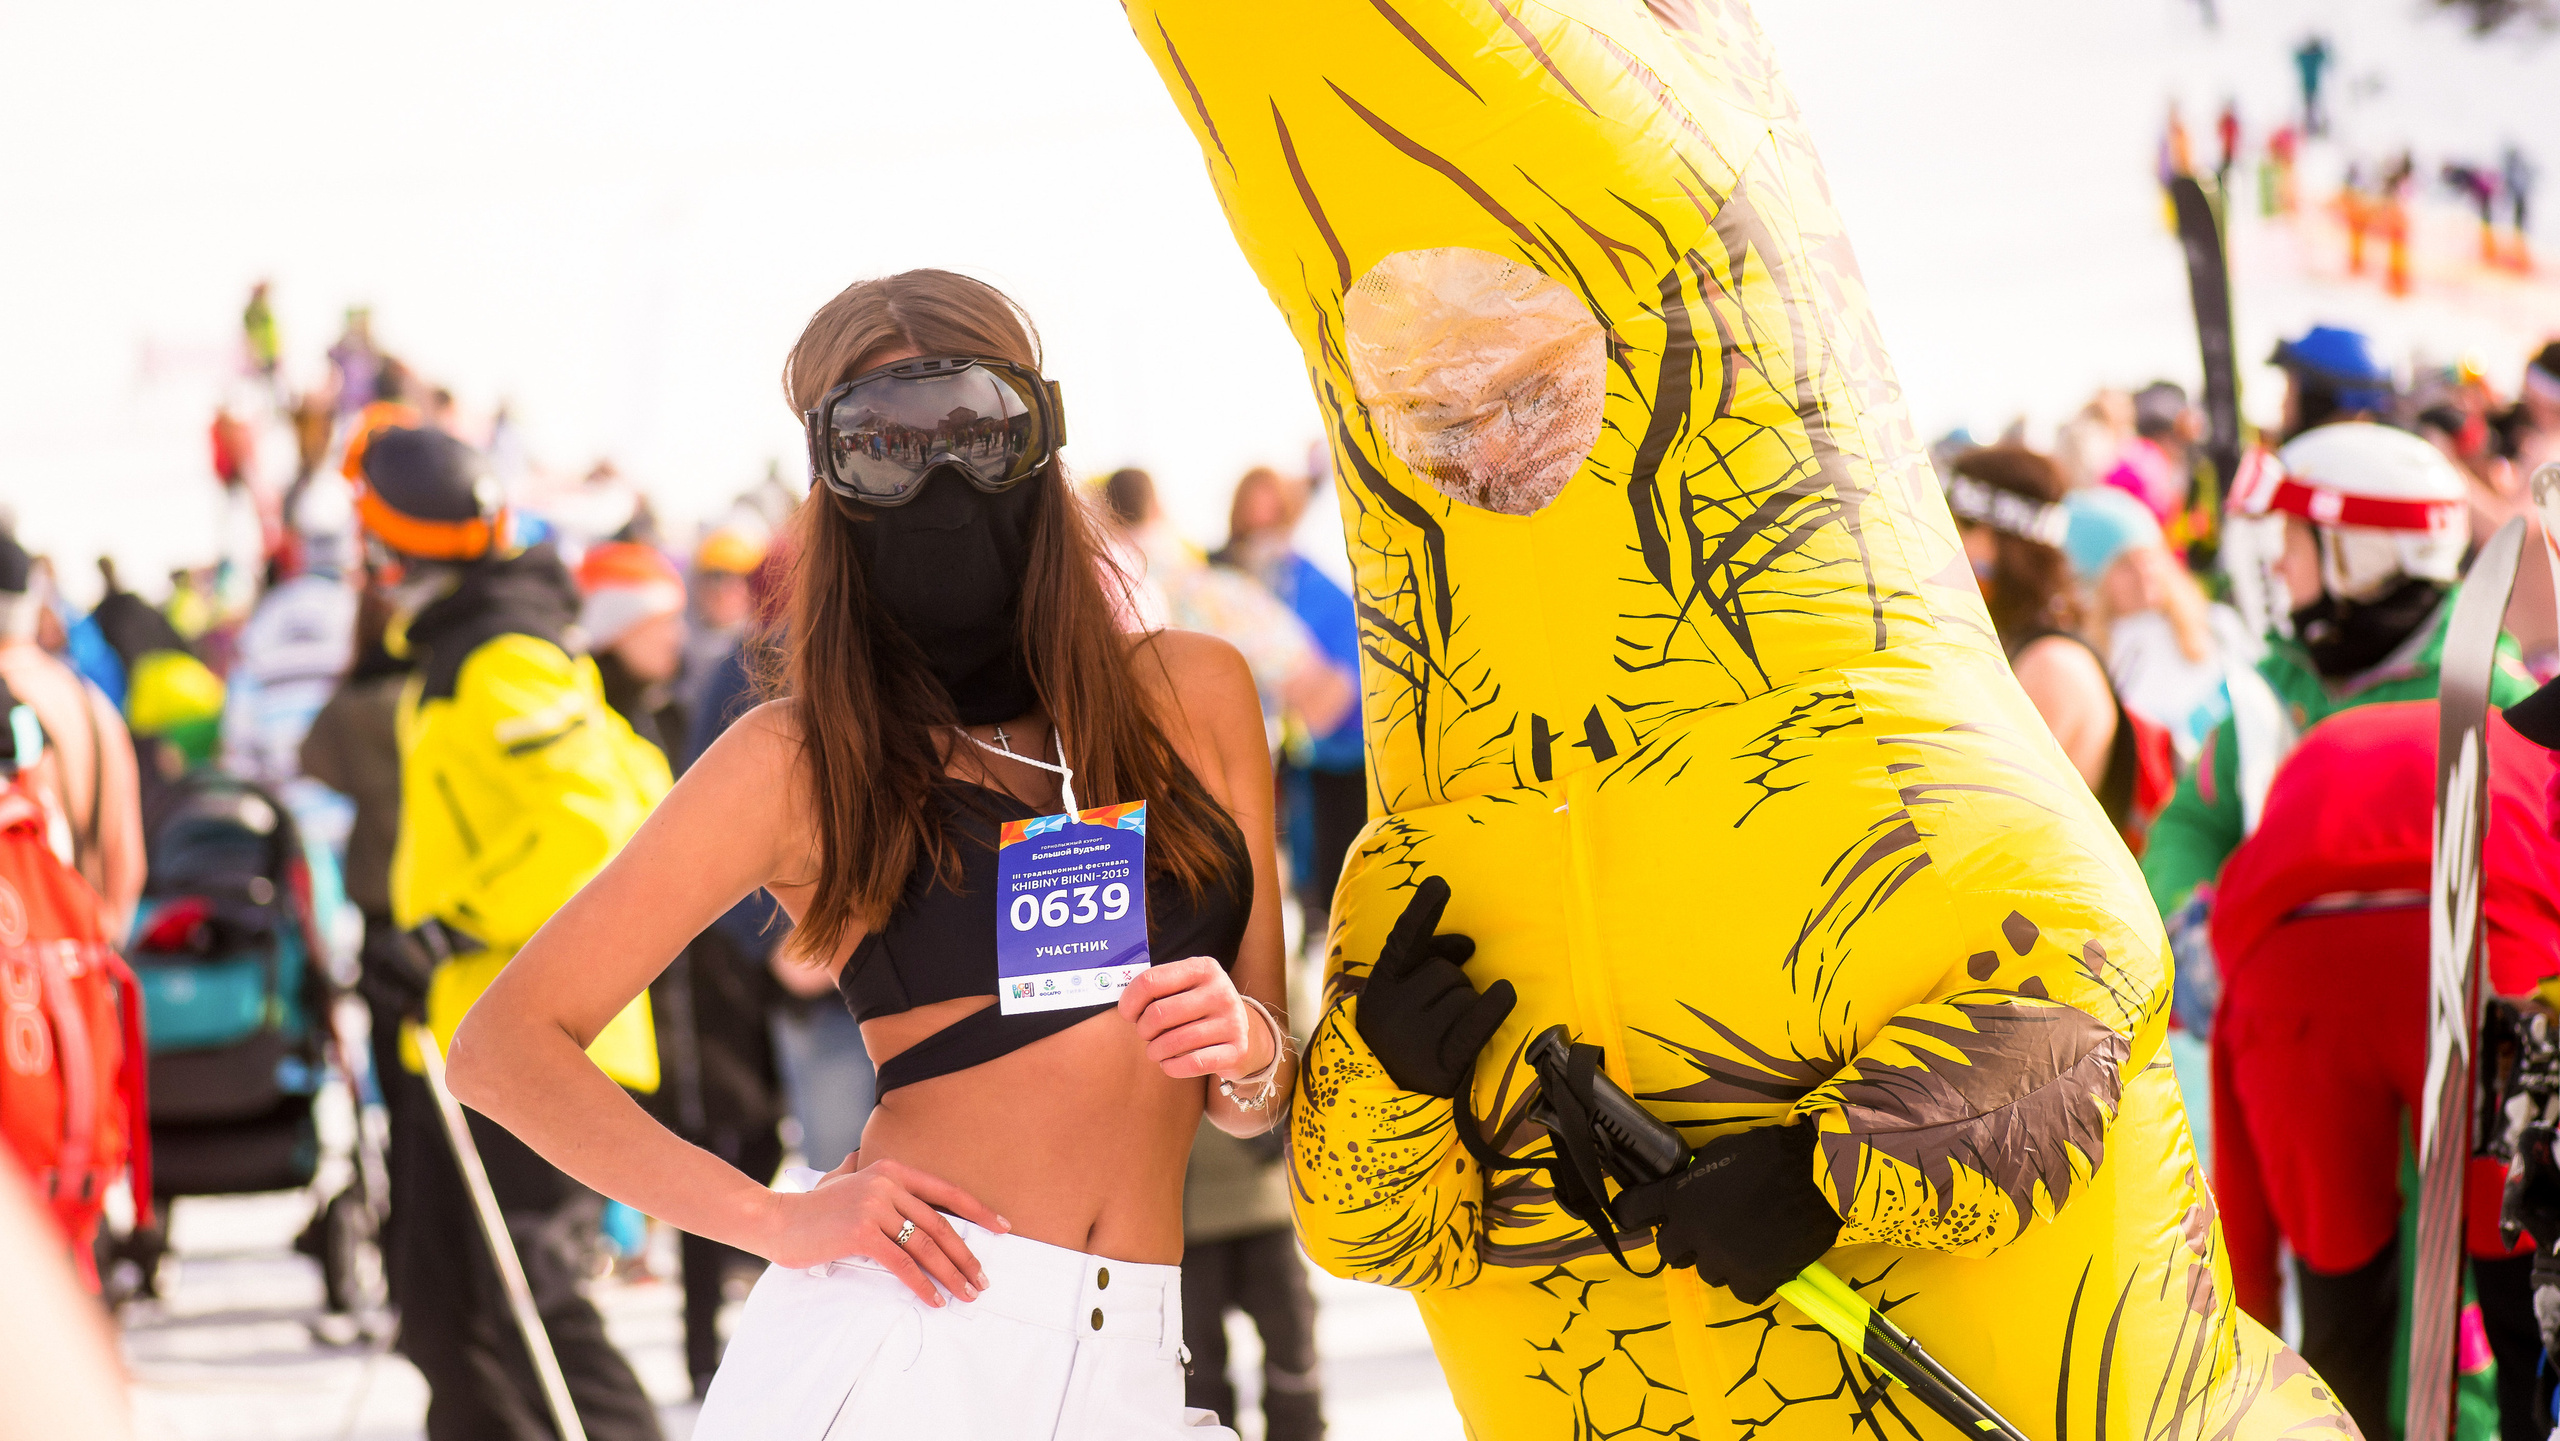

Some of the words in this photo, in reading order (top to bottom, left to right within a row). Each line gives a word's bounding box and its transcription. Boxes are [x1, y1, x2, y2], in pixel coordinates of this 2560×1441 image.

[1032, 848, 1071, 861] Большой
[1073, 844, 1111, 855] Вудъявр
[1012, 877, 1059, 892] KHIBINY
[1061, 867, 1130, 886] BIKINI-2019
[1023, 864, 1083, 879] традиционный
[1085, 859, 1129, 870] фестиваль
[1010, 882, 1130, 932] 0639
[1035, 939, 1110, 958] УЧАСТНИК
[1676, 1152, 1739, 1190] ziener
